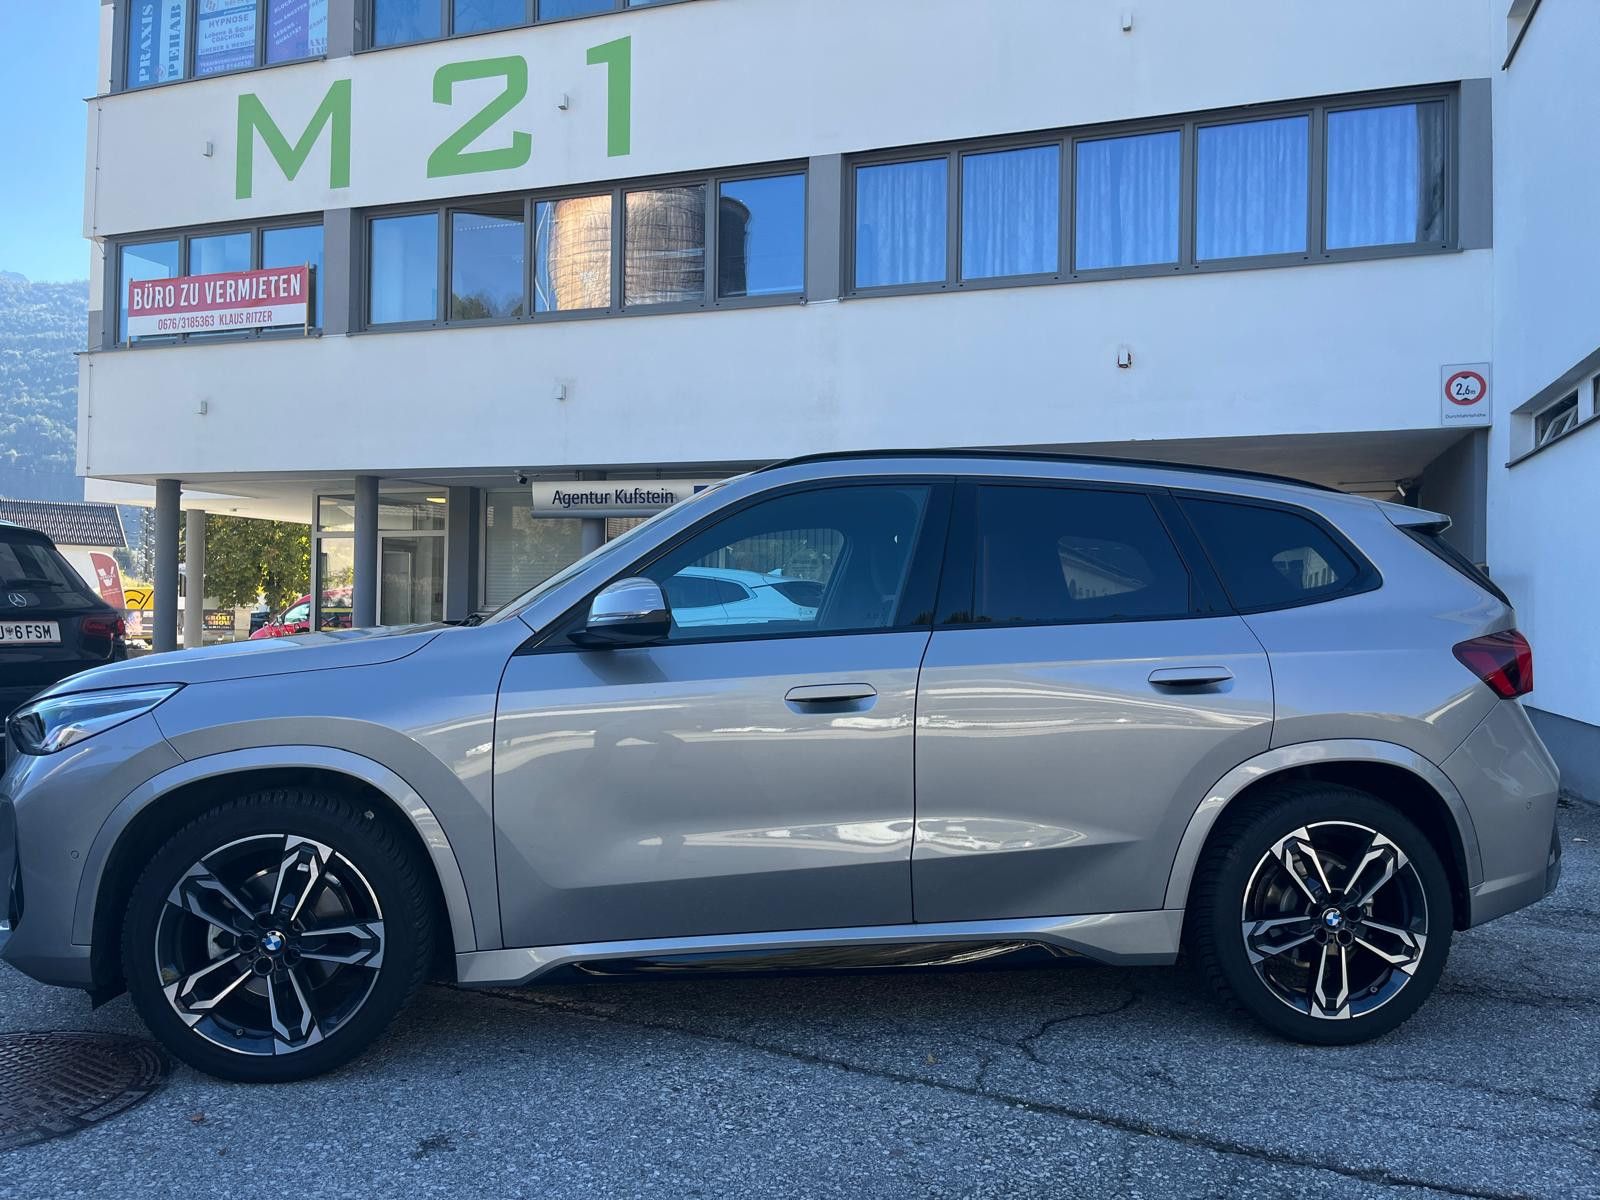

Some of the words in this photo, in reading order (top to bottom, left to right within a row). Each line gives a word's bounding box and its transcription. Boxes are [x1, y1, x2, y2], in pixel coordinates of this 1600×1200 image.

[208, 14, 249, 29] HYPNOSE
[139, 4, 153, 82] PRAXIS
[235, 78, 352, 200] M
[133, 284, 175, 310] BÜRO
[180, 282, 199, 306] ZU
[204, 273, 301, 304] VERMIETEN
[158, 315, 215, 331] 0676/3185363
[219, 312, 244, 326] KLAUS
[245, 310, 273, 324] RITZER
[552, 489, 611, 508] Agentur
[615, 487, 674, 504] Kufstein
